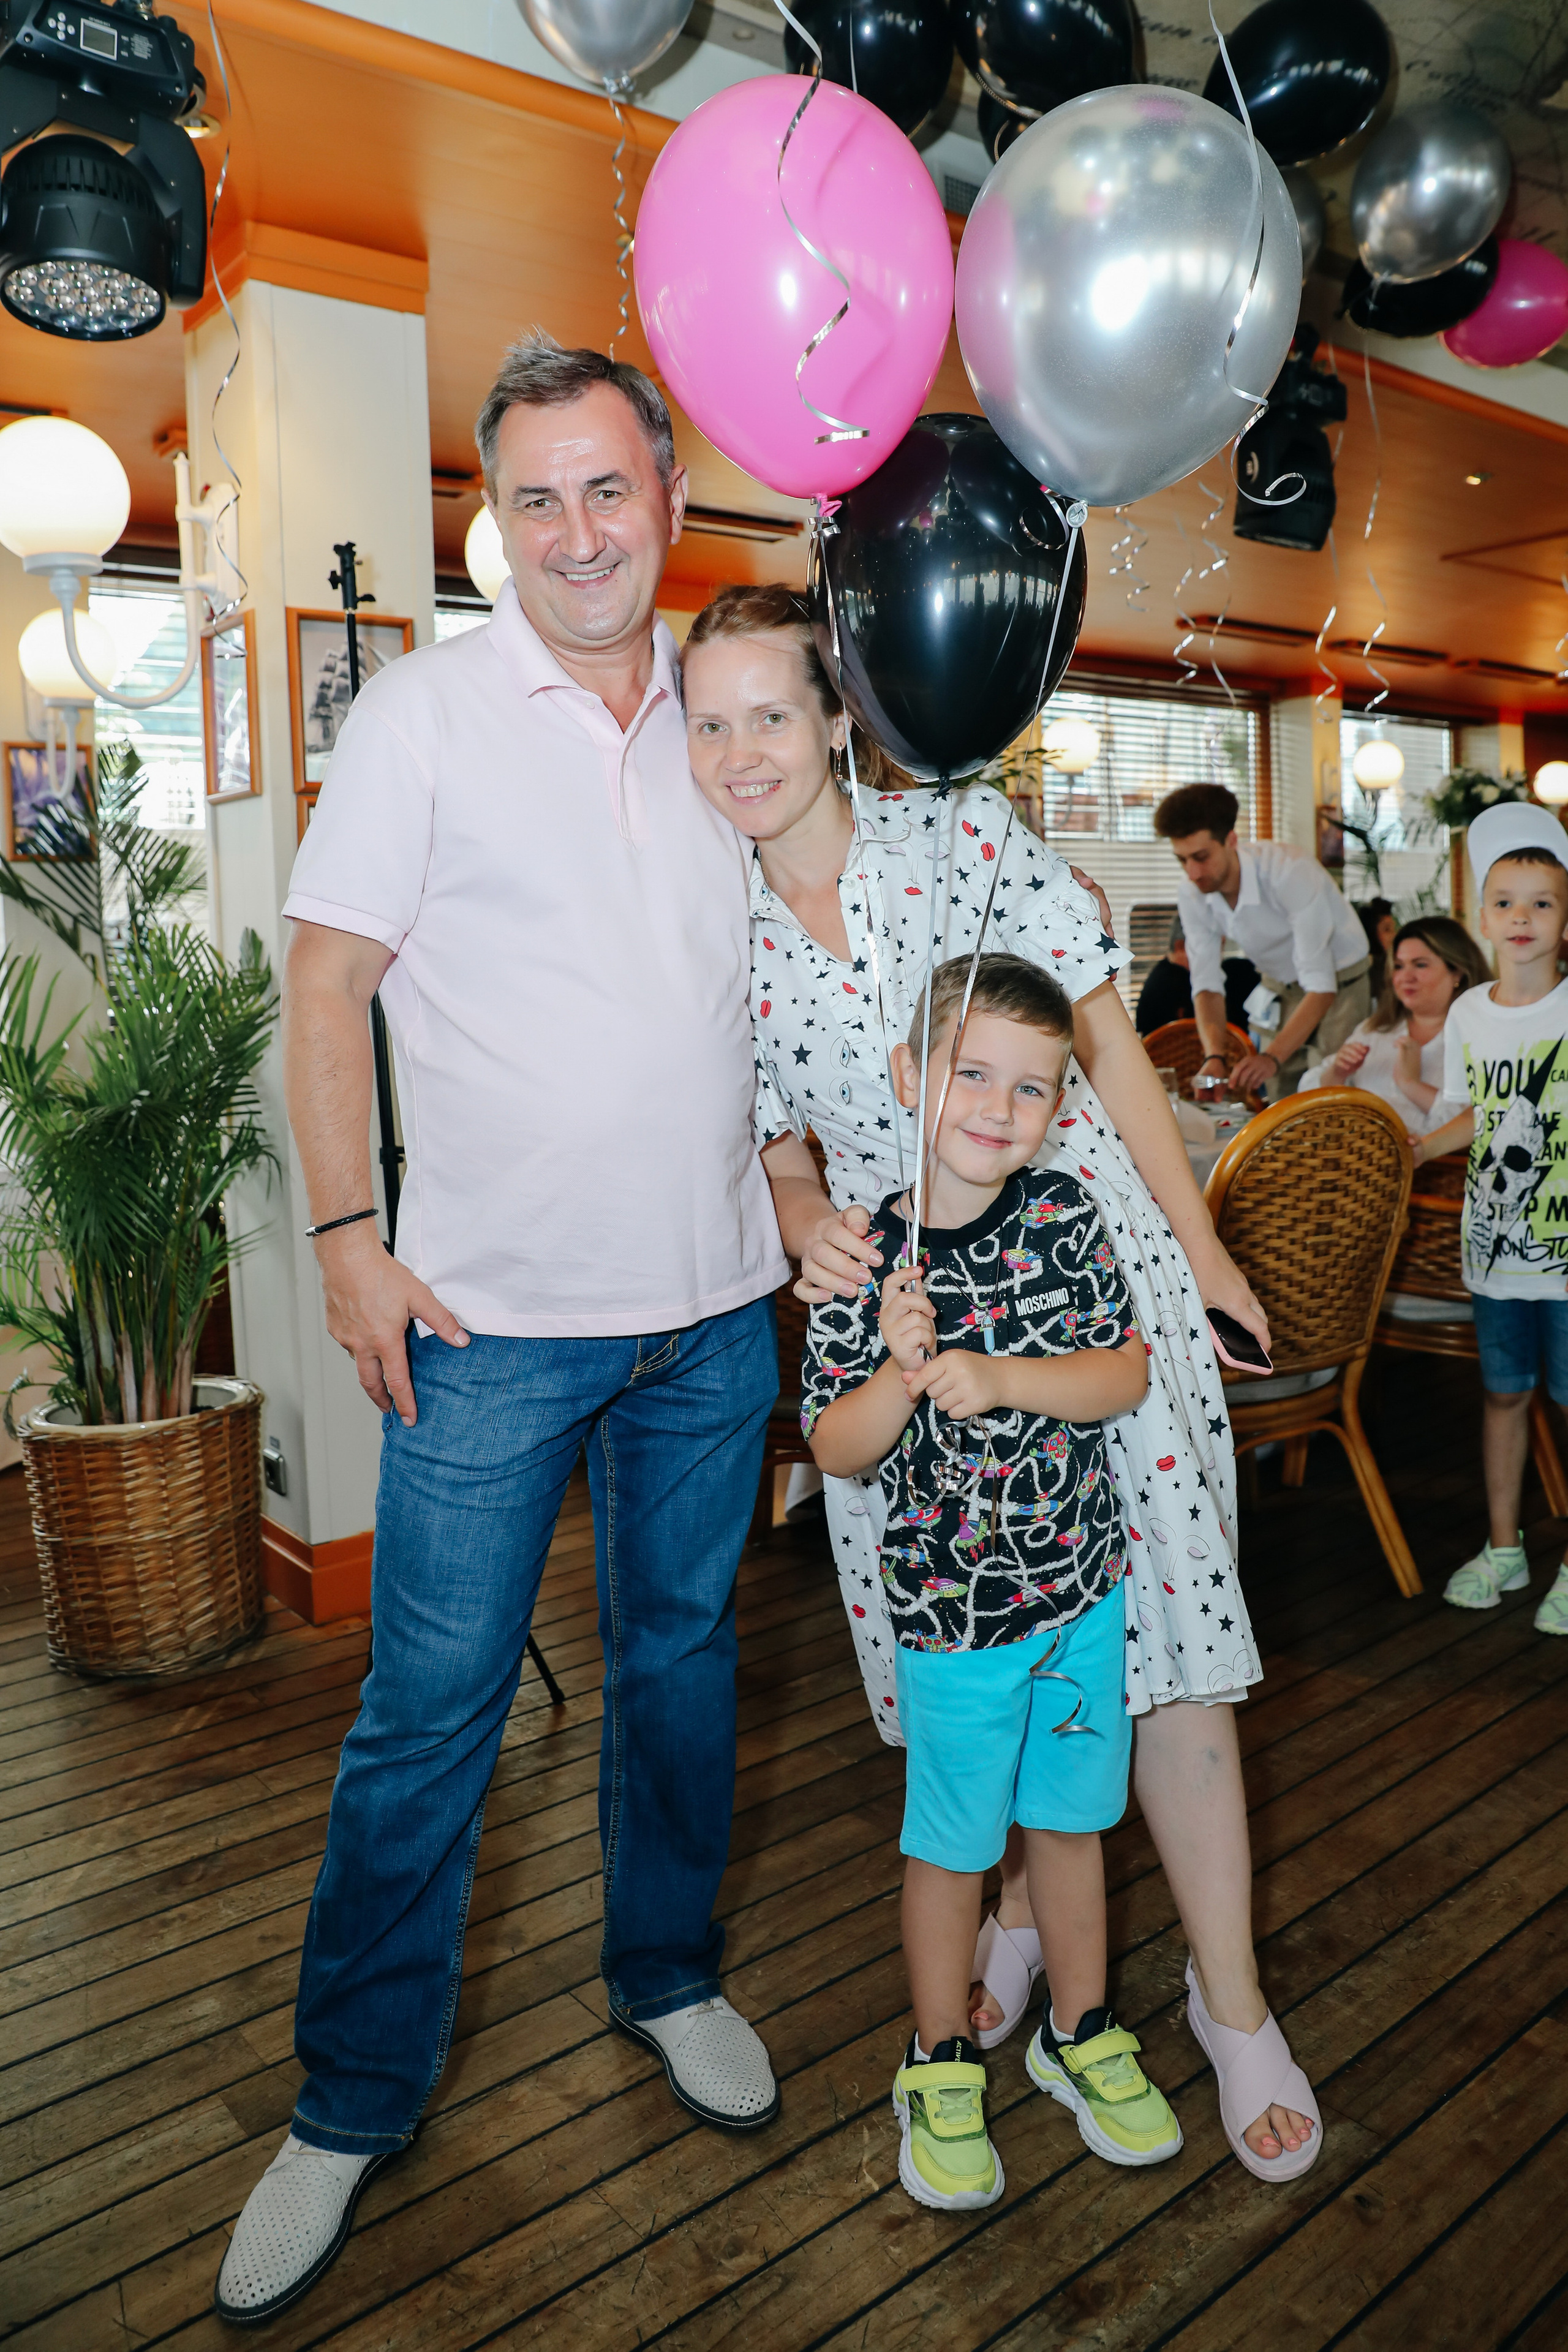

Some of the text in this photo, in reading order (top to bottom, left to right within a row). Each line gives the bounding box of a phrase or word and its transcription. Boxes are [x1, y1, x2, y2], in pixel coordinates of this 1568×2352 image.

[1483, 1059, 1568, 1099] YOU CA
[1534, 1142, 1566, 1160] AN
[1487, 1196, 1538, 1221] STP
[1014, 1287, 1069, 1317] MOSCHINO
